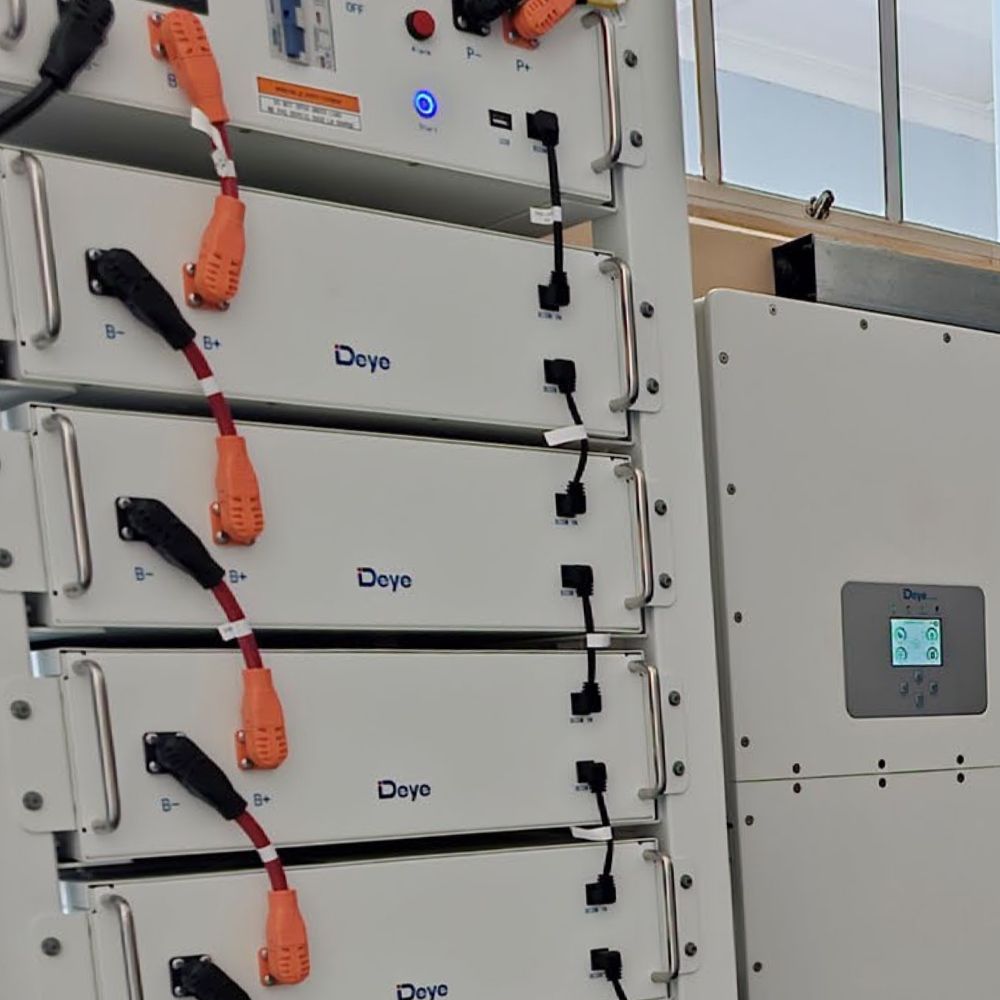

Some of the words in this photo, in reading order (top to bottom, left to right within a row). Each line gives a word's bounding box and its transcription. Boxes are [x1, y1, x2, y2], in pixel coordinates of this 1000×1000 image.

[346, 2, 364, 14] OFF
[516, 59, 531, 71] P+
[105, 324, 125, 339] B-
[203, 336, 221, 350] B+
[334, 344, 390, 373] Deye
[135, 567, 154, 581] B-
[229, 570, 247, 583] B+
[357, 567, 412, 592] Deye
[378, 780, 431, 802] Deye
[161, 798, 180, 812] B-
[254, 793, 270, 806] B+
